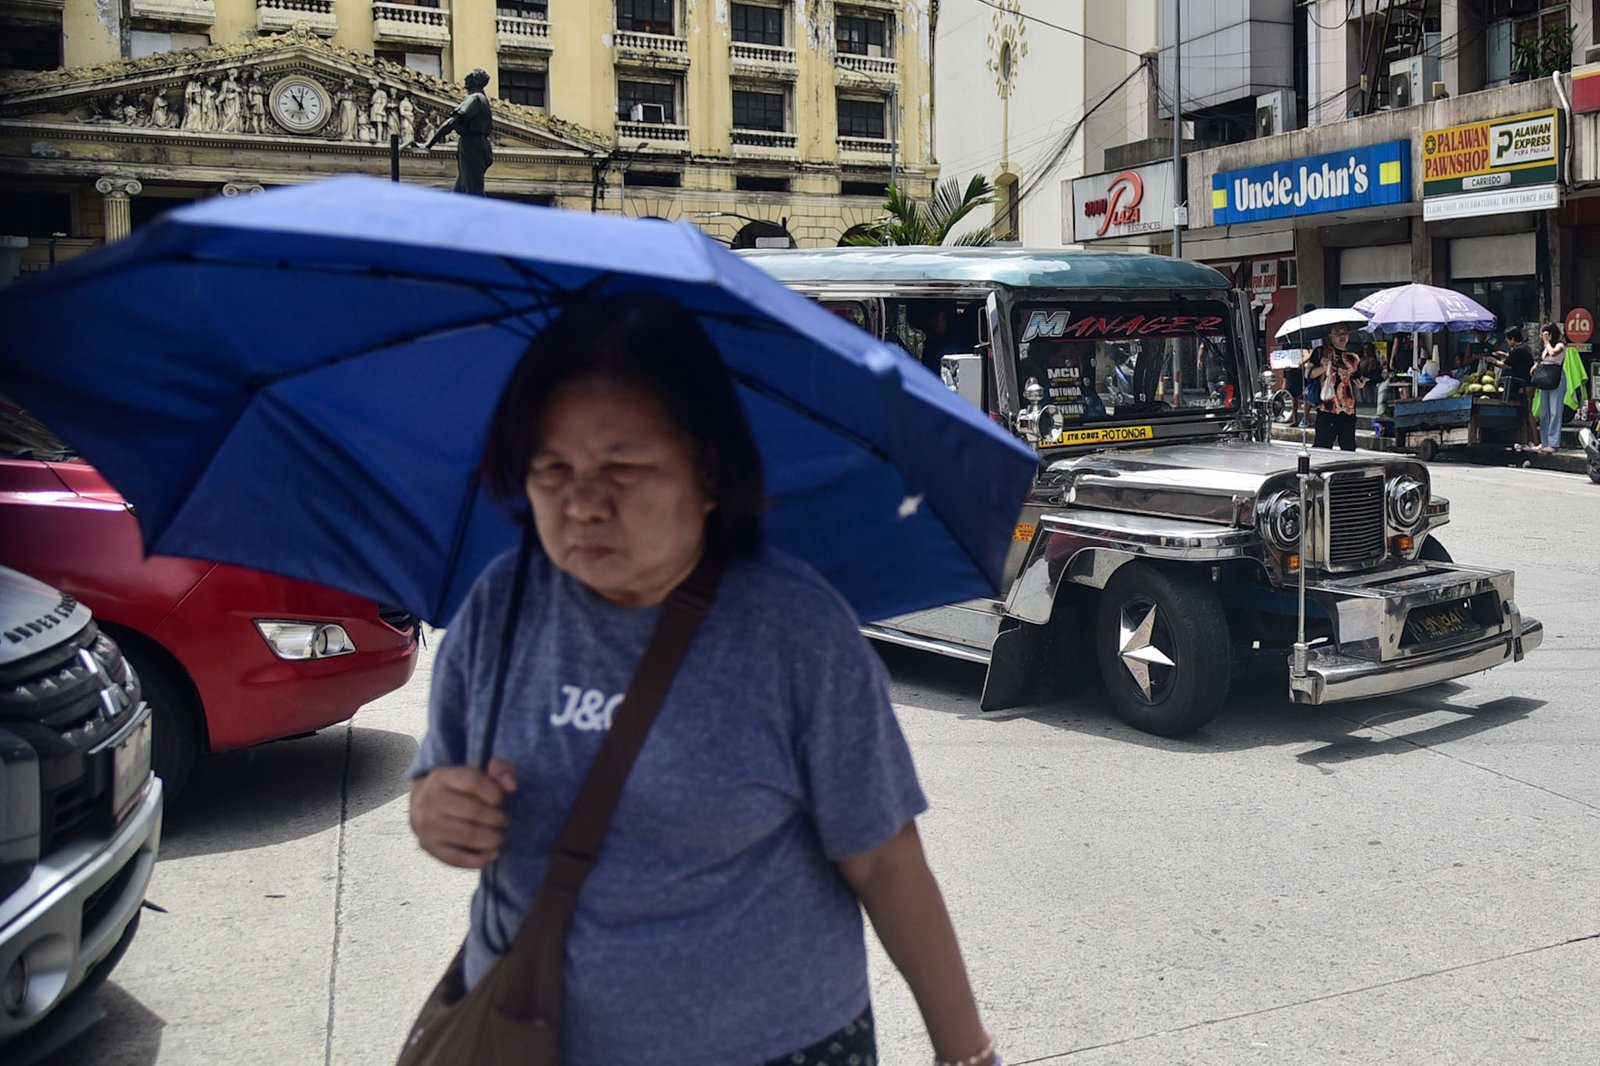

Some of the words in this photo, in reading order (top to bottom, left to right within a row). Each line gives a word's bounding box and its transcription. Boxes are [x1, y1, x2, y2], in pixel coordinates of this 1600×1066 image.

[1437, 126, 1489, 153] PALAWAN
[1514, 134, 1551, 150] EXPRESS
[1425, 149, 1489, 178] PAWNSHOP
[1234, 170, 1293, 212] Uncle
[1294, 156, 1369, 207] John's
[1471, 175, 1502, 187] CARRIEDO
[1127, 221, 1161, 234] RESIDENCES
[1021, 310, 1223, 343] MANAGER
[1568, 313, 1590, 332] ria
[1047, 367, 1080, 379] MCU
[1049, 386, 1082, 397] ROTONDA
[1056, 404, 1084, 415] YUMAN
[1080, 431, 1100, 440] CRUZ
[1101, 428, 1146, 440] ROTONDA
